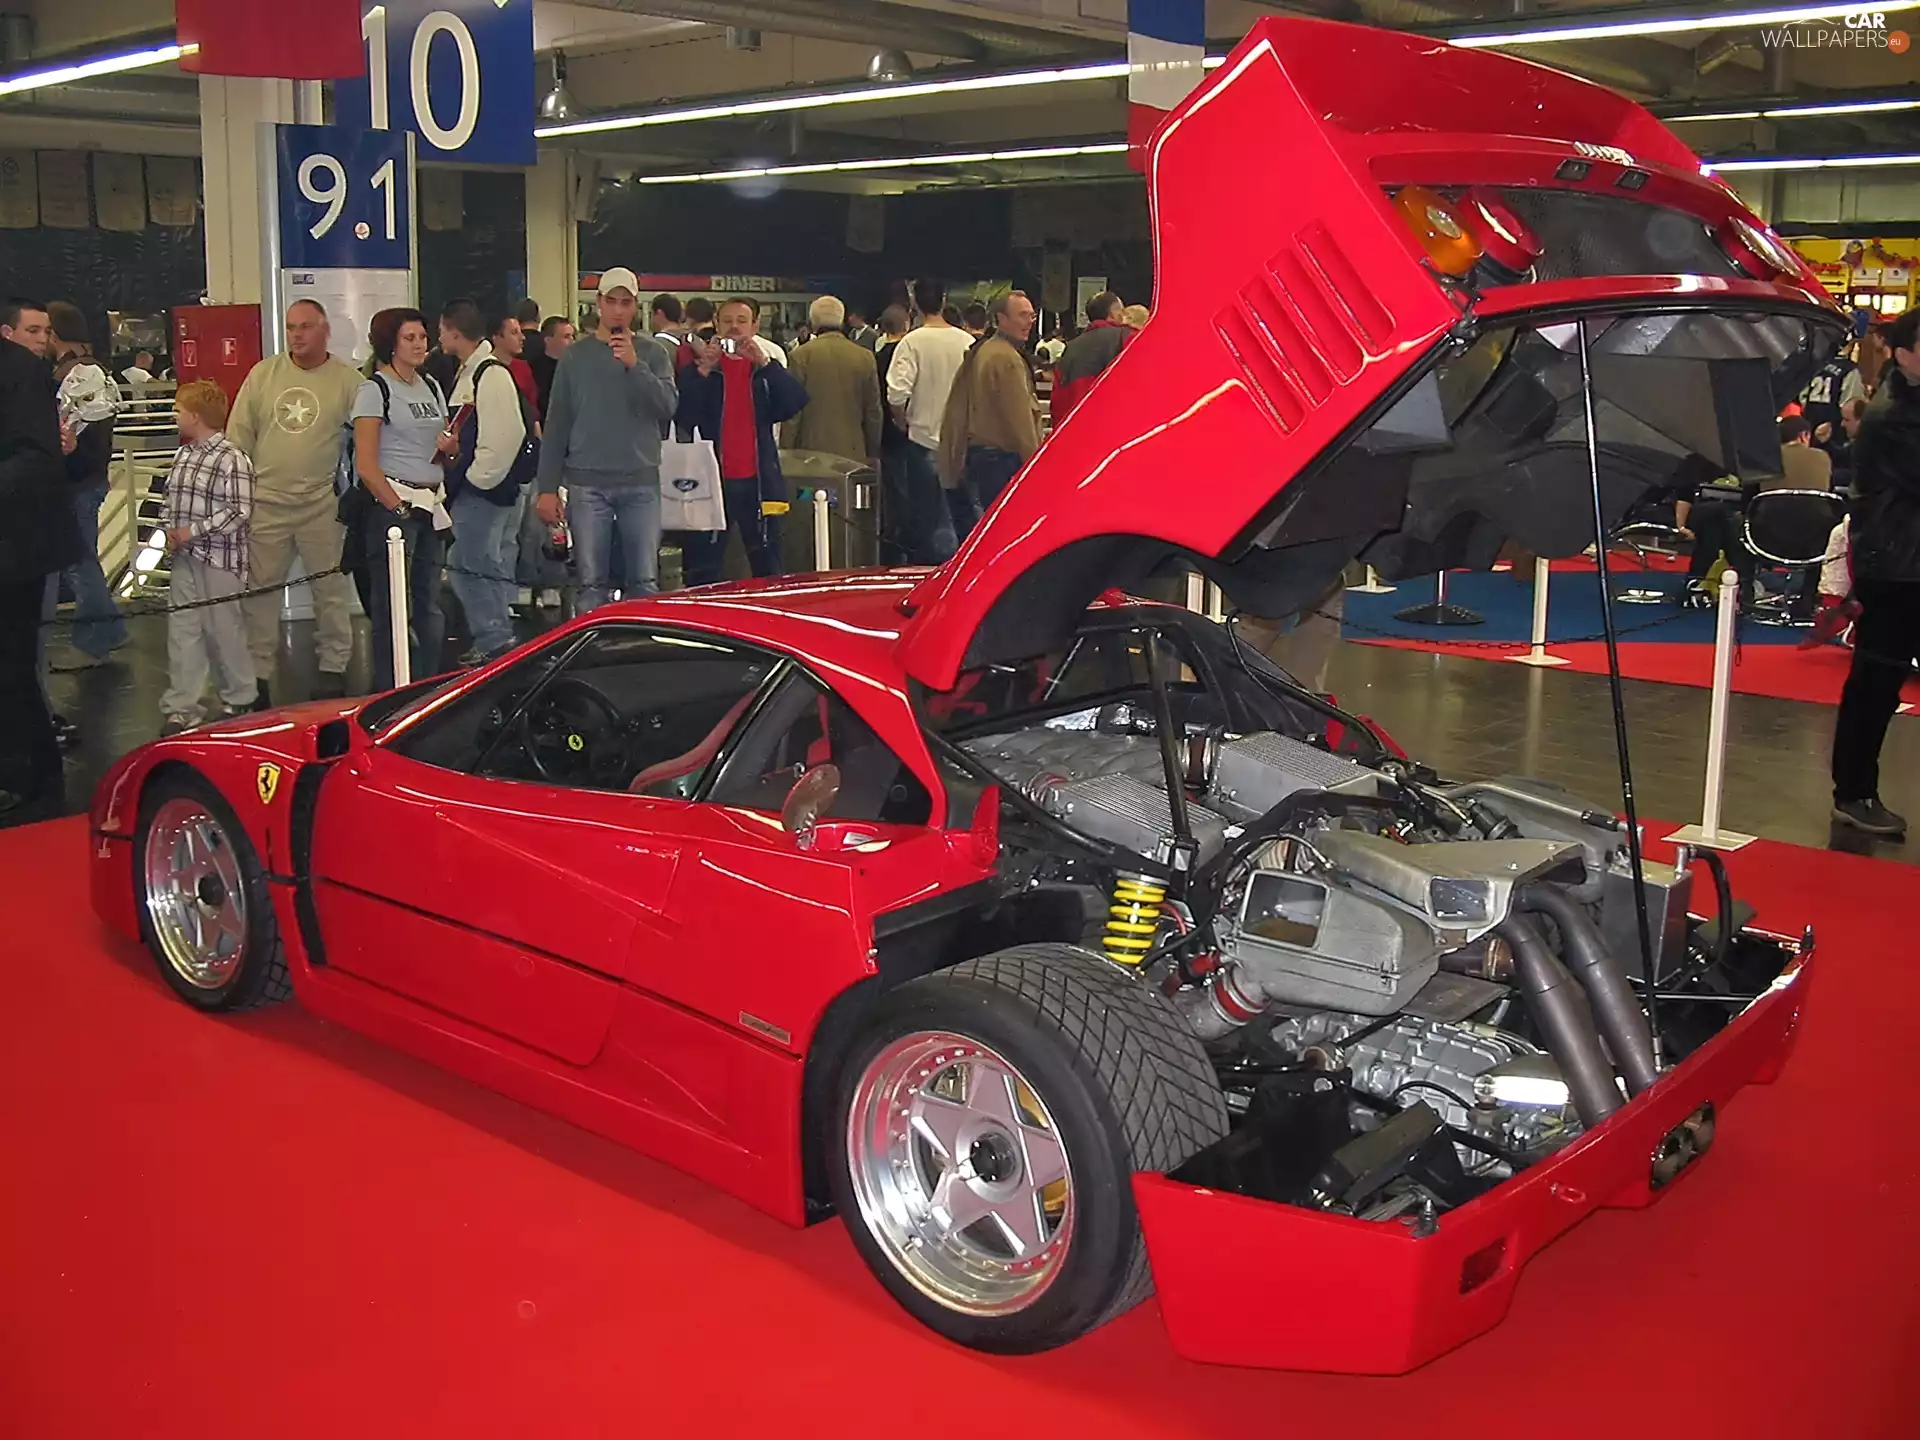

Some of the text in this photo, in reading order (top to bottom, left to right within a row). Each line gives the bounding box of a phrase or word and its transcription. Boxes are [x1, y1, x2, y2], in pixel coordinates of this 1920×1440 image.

[362, 5, 481, 151] 10
[298, 153, 397, 240] 9.1
[1809, 376, 1832, 403] 21
